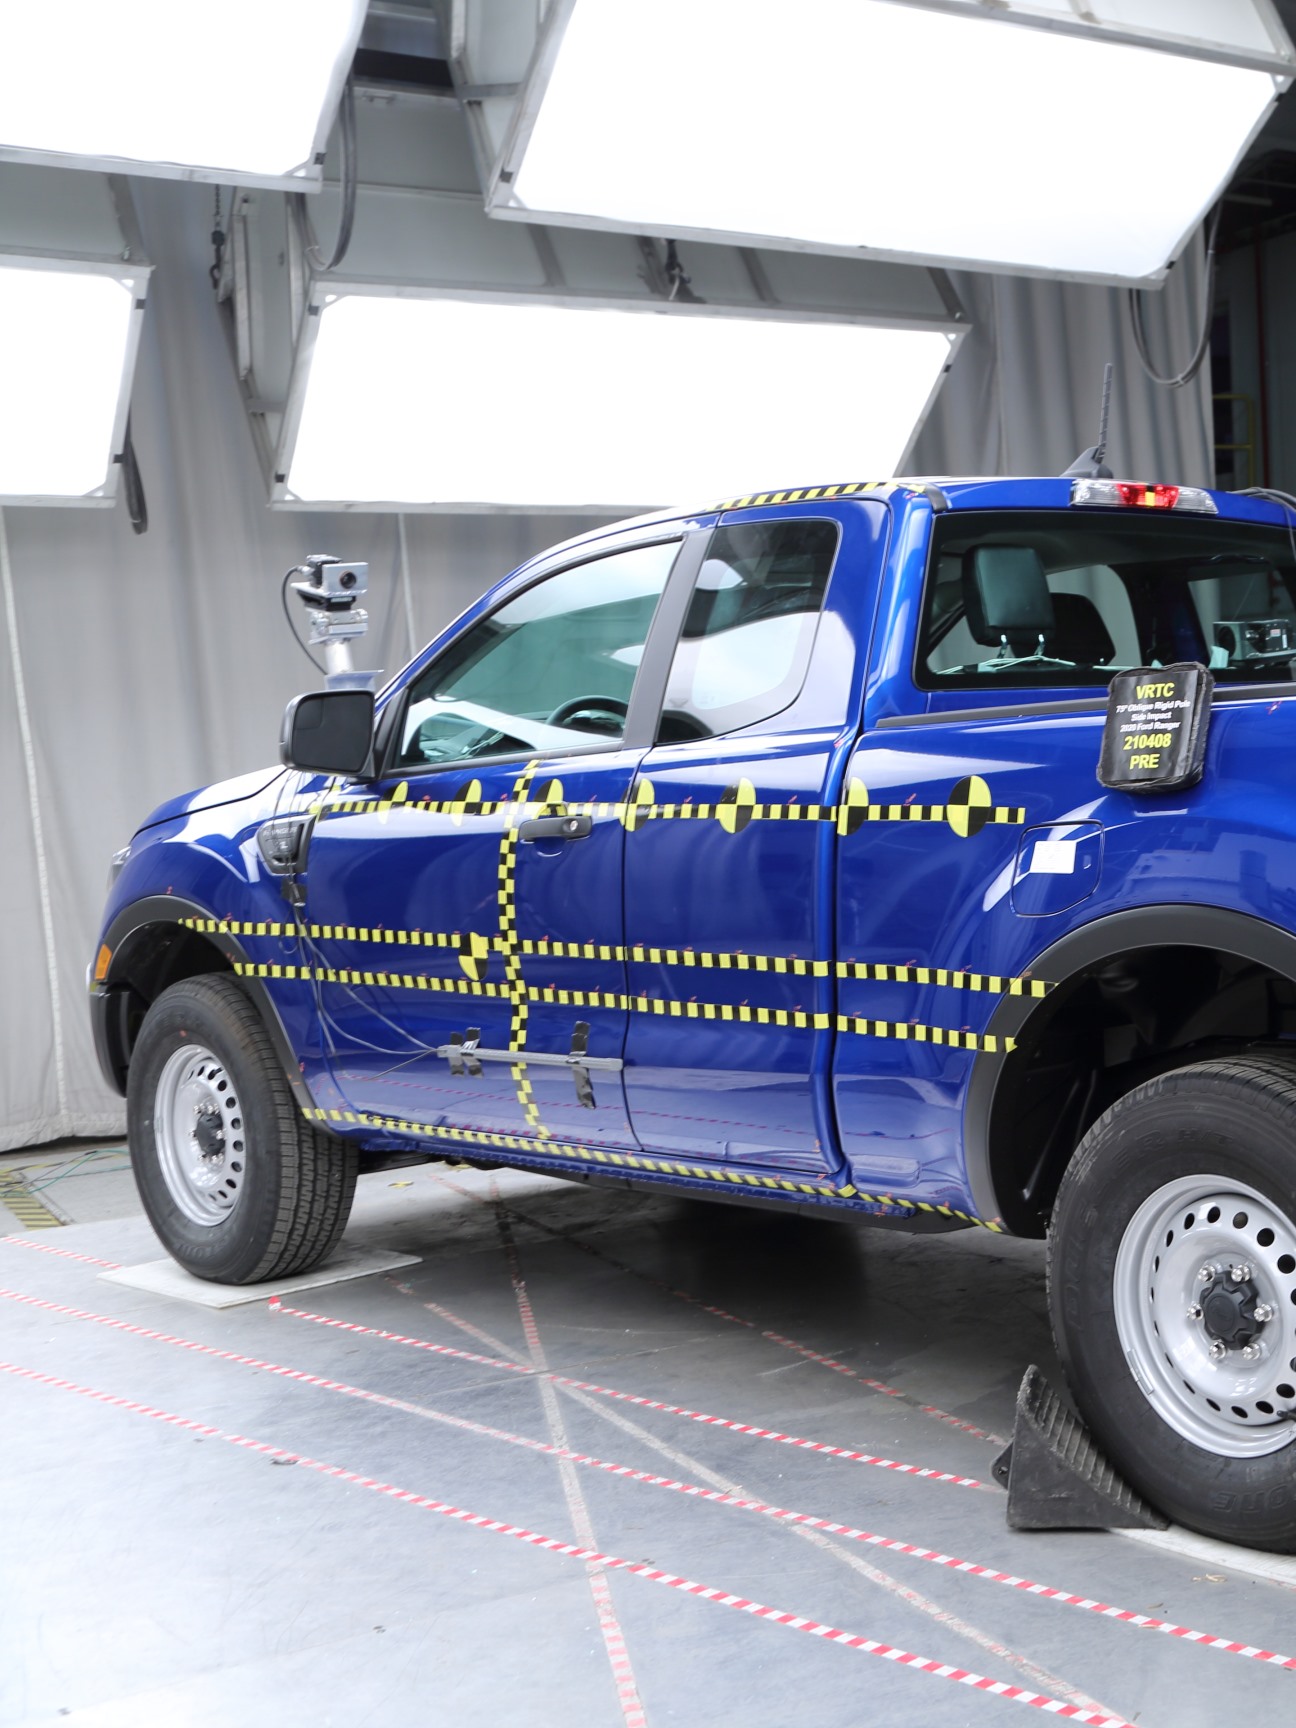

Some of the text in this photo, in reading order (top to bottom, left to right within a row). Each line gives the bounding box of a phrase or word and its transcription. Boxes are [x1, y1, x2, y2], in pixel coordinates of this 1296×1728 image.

[1136, 682, 1175, 699] VRTC
[1128, 702, 1153, 713] Oblique
[1154, 701, 1174, 711] Rigid
[1174, 700, 1191, 709] Pole
[1131, 712, 1172, 721] Side Impact
[1137, 722, 1153, 731] Ford
[1154, 721, 1181, 731] Ranger
[1122, 733, 1172, 750] 210408
[1129, 754, 1160, 770] PRE
